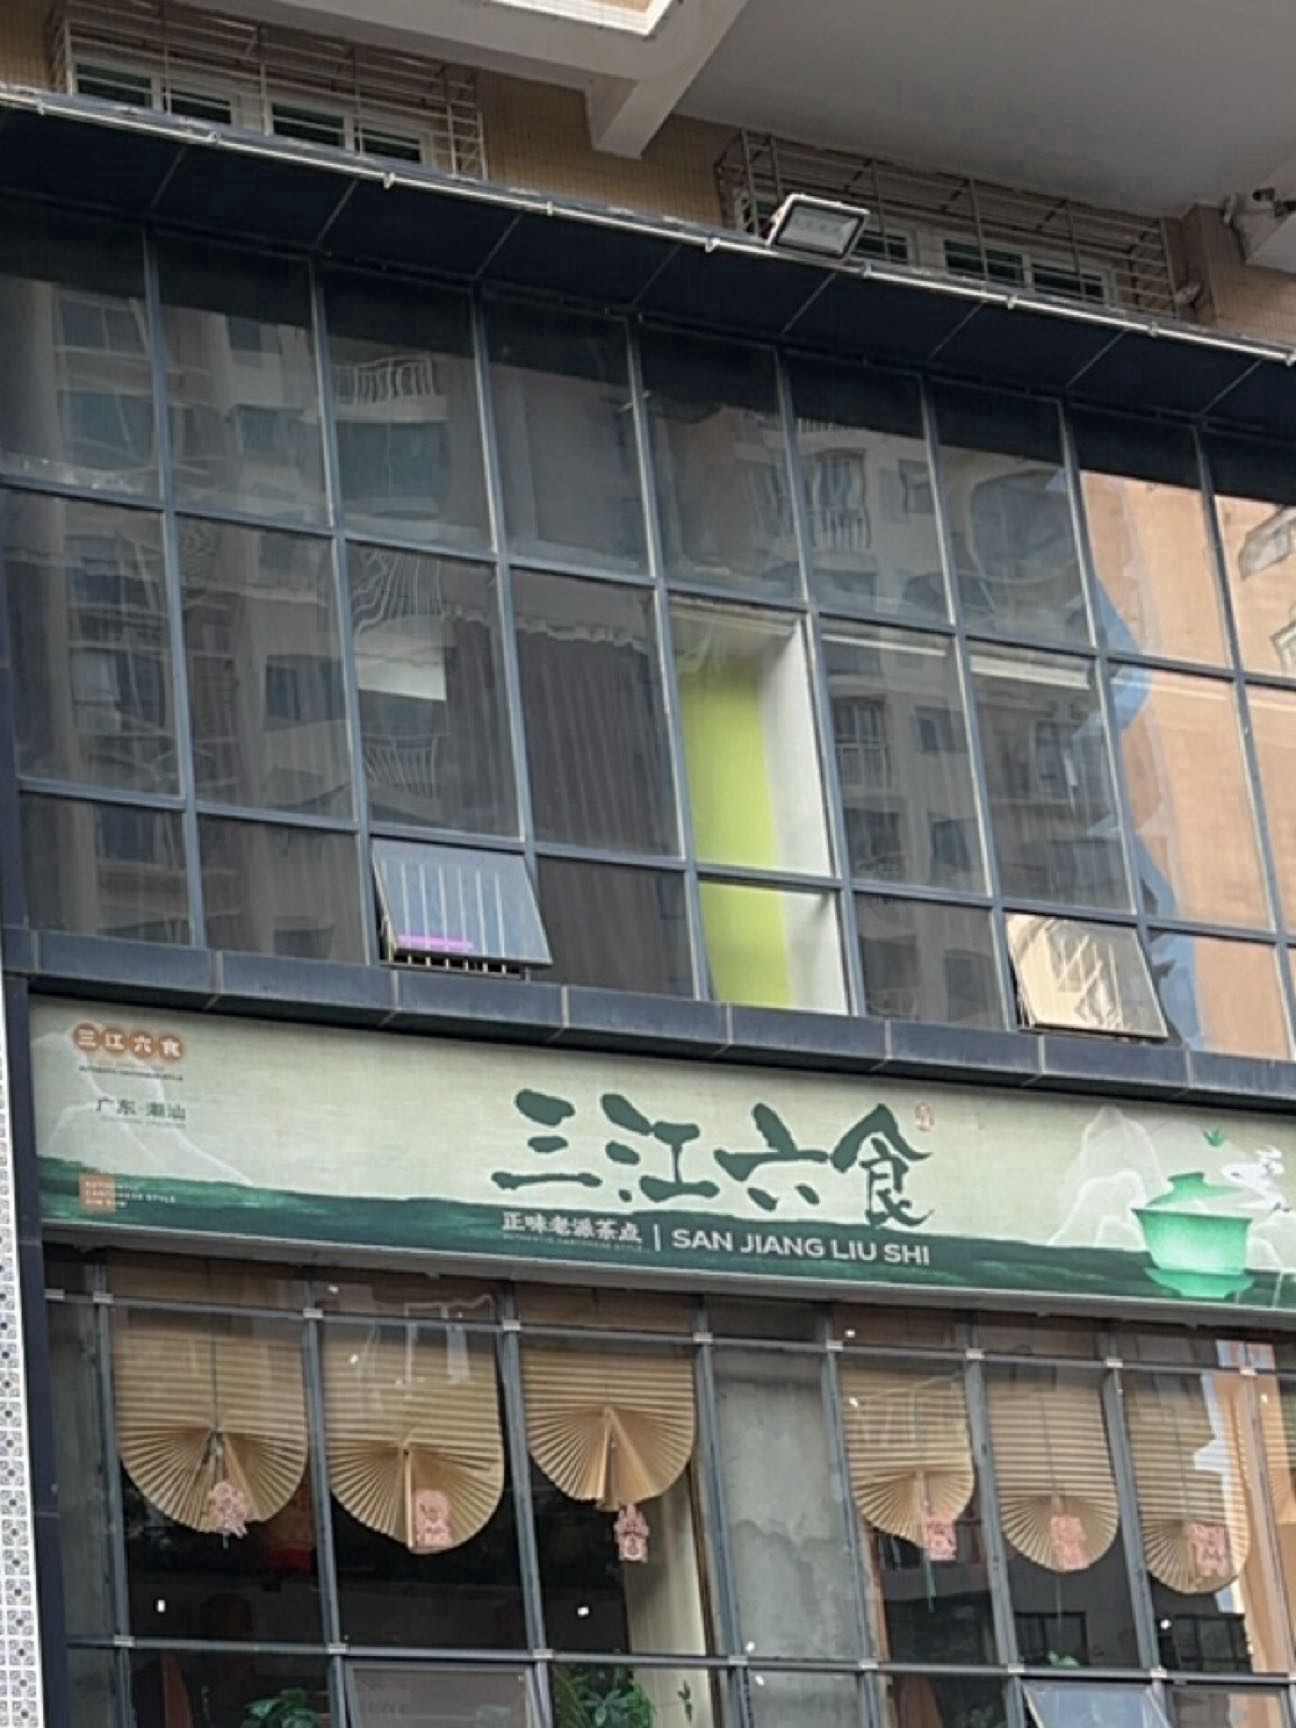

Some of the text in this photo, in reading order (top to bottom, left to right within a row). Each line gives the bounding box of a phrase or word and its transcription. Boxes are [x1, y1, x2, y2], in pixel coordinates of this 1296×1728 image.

[491, 1088, 932, 1227] 三江六食
[672, 1229, 929, 1266] SAN JIANG LIU SHI
